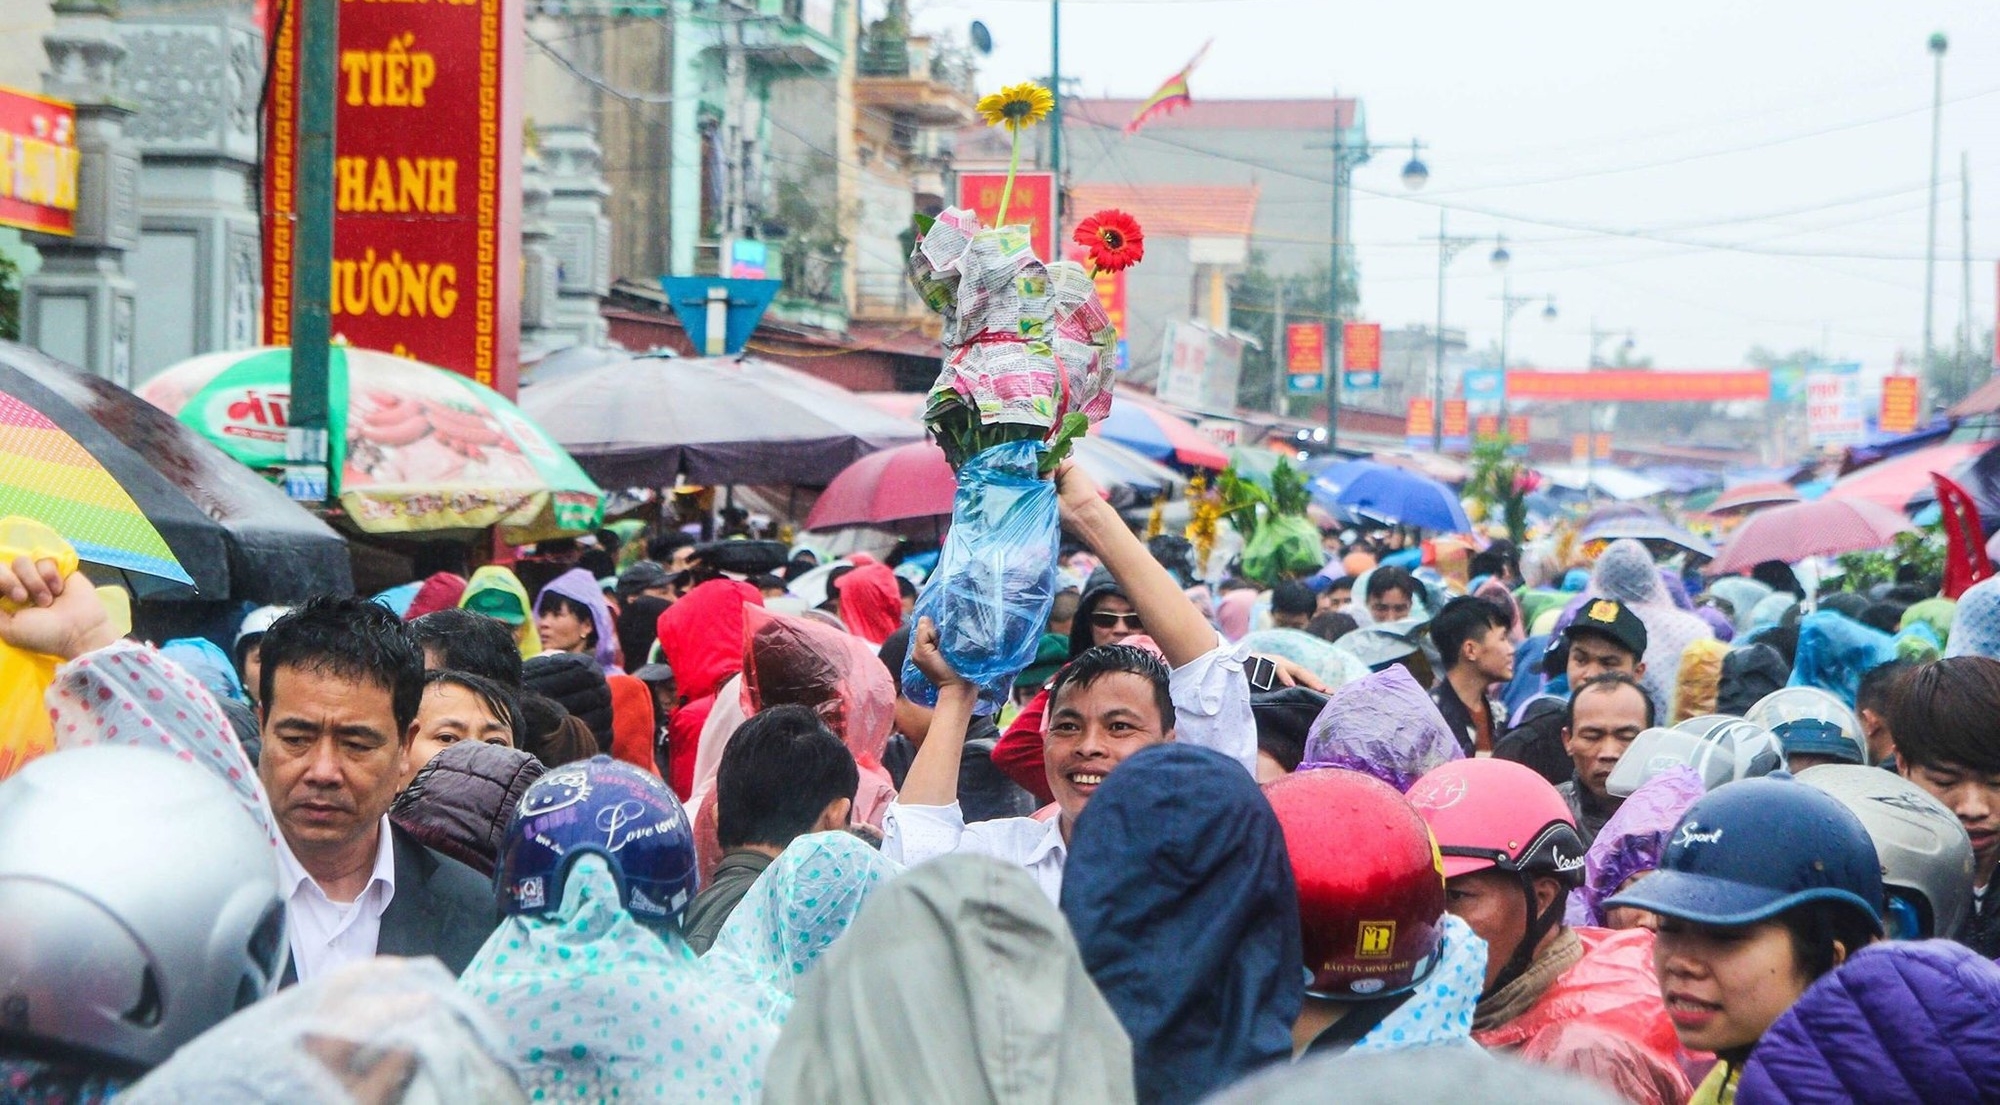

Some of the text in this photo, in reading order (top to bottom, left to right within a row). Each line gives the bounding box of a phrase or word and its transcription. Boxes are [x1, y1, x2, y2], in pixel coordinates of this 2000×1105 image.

[341, 31, 436, 107] TIẾP
[333, 156, 458, 214] HANH
[596, 800, 653, 853] Love
[1672, 822, 1723, 848] Sport
